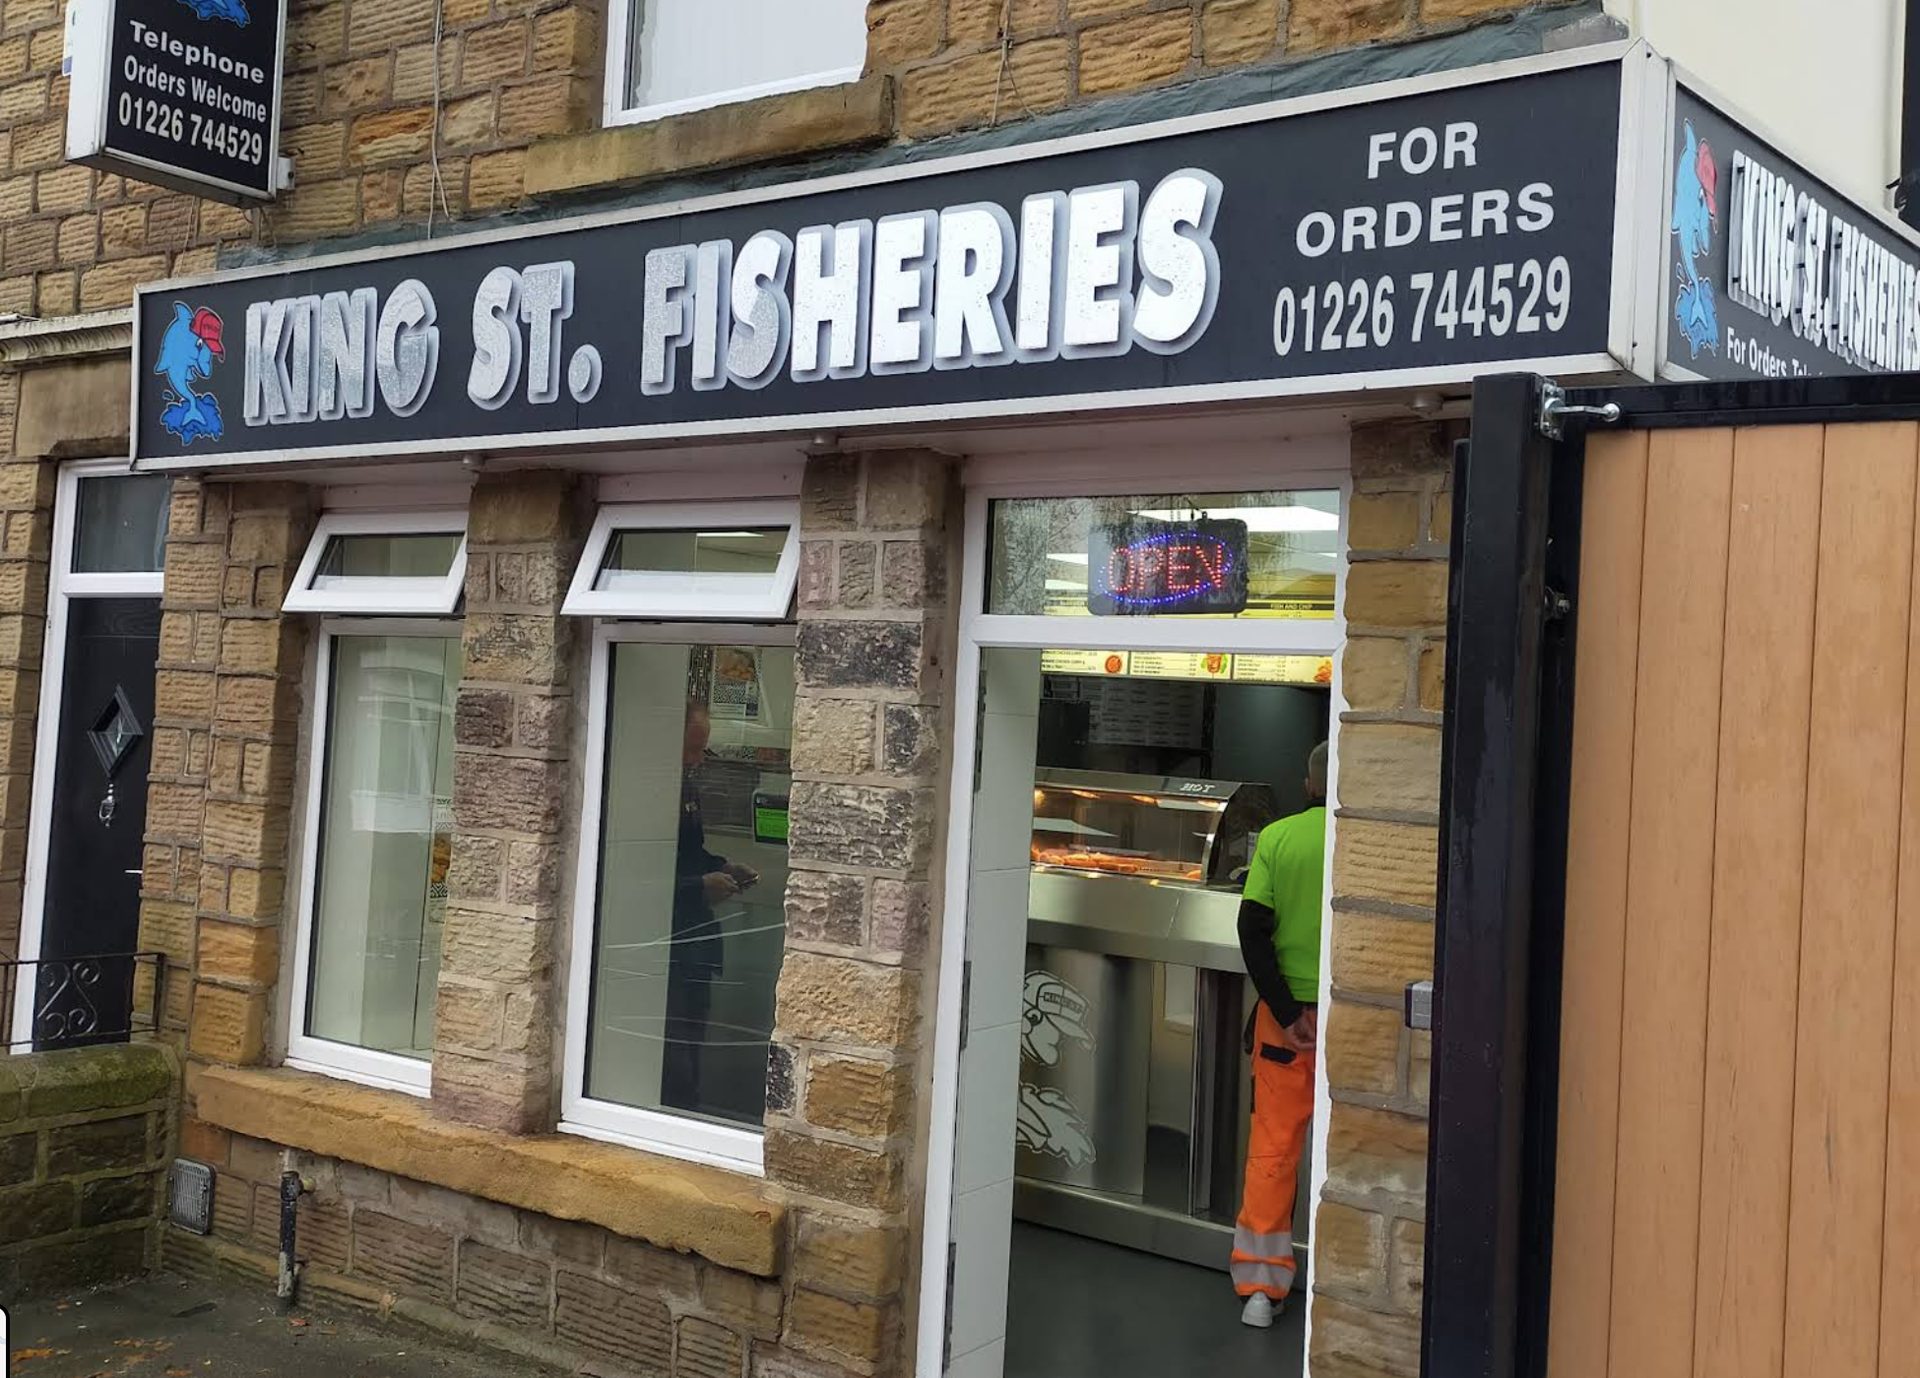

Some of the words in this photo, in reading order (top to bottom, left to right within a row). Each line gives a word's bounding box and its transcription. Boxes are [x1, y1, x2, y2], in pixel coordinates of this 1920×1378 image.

[130, 20, 265, 84] Telephone
[124, 55, 186, 97] Orders
[191, 76, 267, 123] Welcome
[119, 91, 183, 142] 01226
[190, 114, 262, 165] 744529
[1367, 121, 1478, 179] FOR
[1296, 182, 1555, 257] ORDERS
[1728, 150, 1796, 327] KING
[243, 278, 440, 426] KING
[466, 260, 602, 411] ST.
[641, 168, 1223, 395] FISHERIES
[1273, 275, 1395, 356] 01226
[1410, 255, 1571, 342] 744529
[1727, 326, 1746, 365] For
[1750, 338, 1787, 377] Orders
[1108, 544, 1223, 592] OPEN
[1180, 783, 1216, 793] HOT
